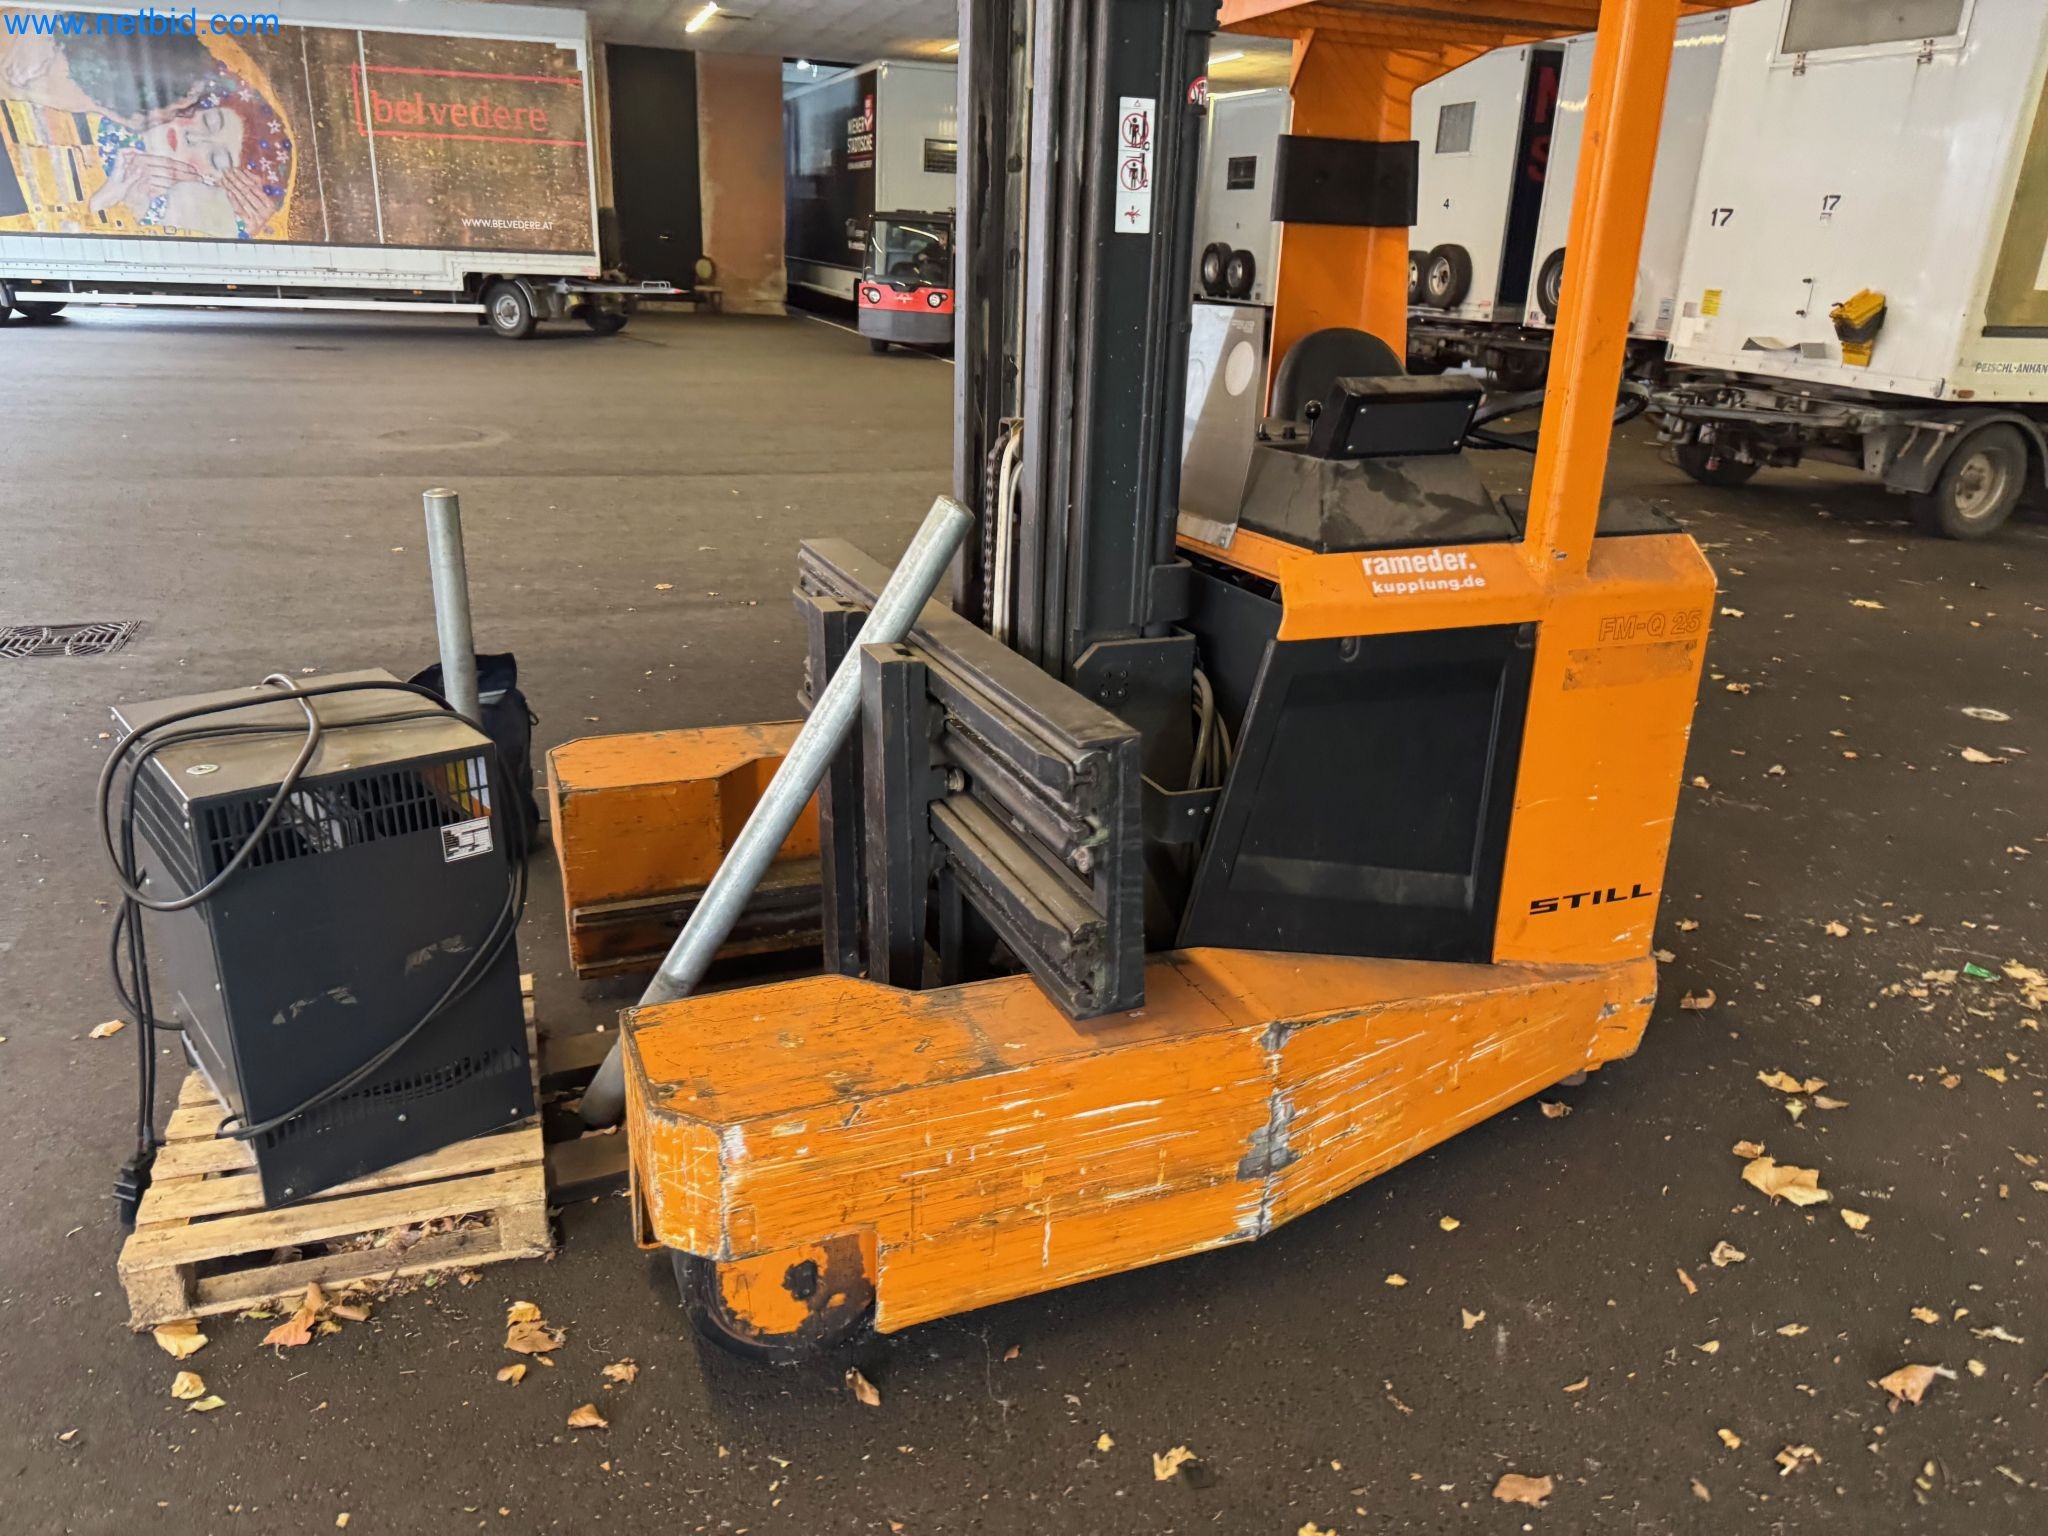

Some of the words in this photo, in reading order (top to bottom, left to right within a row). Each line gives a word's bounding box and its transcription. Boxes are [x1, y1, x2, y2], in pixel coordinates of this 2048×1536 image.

[371, 90, 548, 132] belvedere
[1442, 198, 1450, 210] 4
[1822, 194, 1841, 211] 17
[461, 218, 554, 231] WWW.BELVEDERE.AT
[1711, 208, 1734, 227] 17
[1362, 549, 1478, 576] rameder.
[1372, 575, 1486, 594] kupplung.de
[1598, 612, 1666, 642] FM-Q
[1670, 609, 1702, 636] 25
[1529, 884, 1652, 915] STILL
